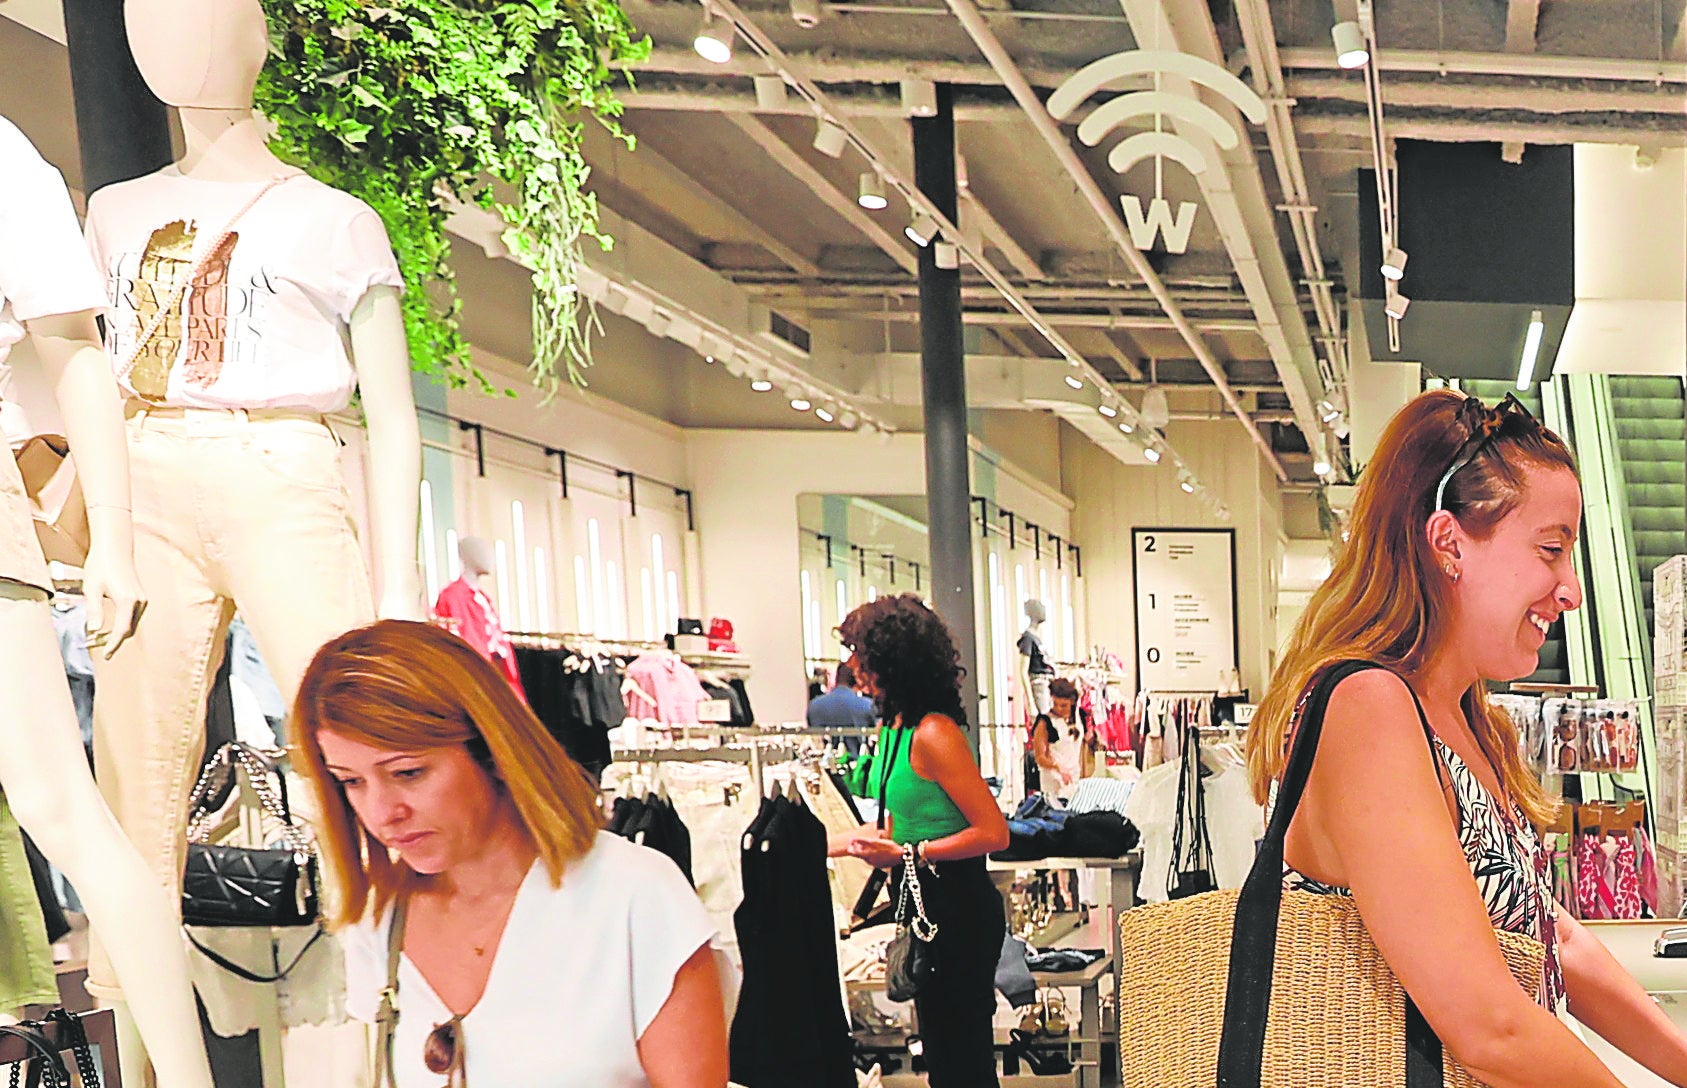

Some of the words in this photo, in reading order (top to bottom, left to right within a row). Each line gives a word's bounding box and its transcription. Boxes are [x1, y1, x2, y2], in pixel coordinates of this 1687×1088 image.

[1120, 195, 1198, 254] W
[107, 278, 262, 318] RAITUDE
[1144, 536, 1156, 552] 2
[1148, 594, 1156, 609] 1
